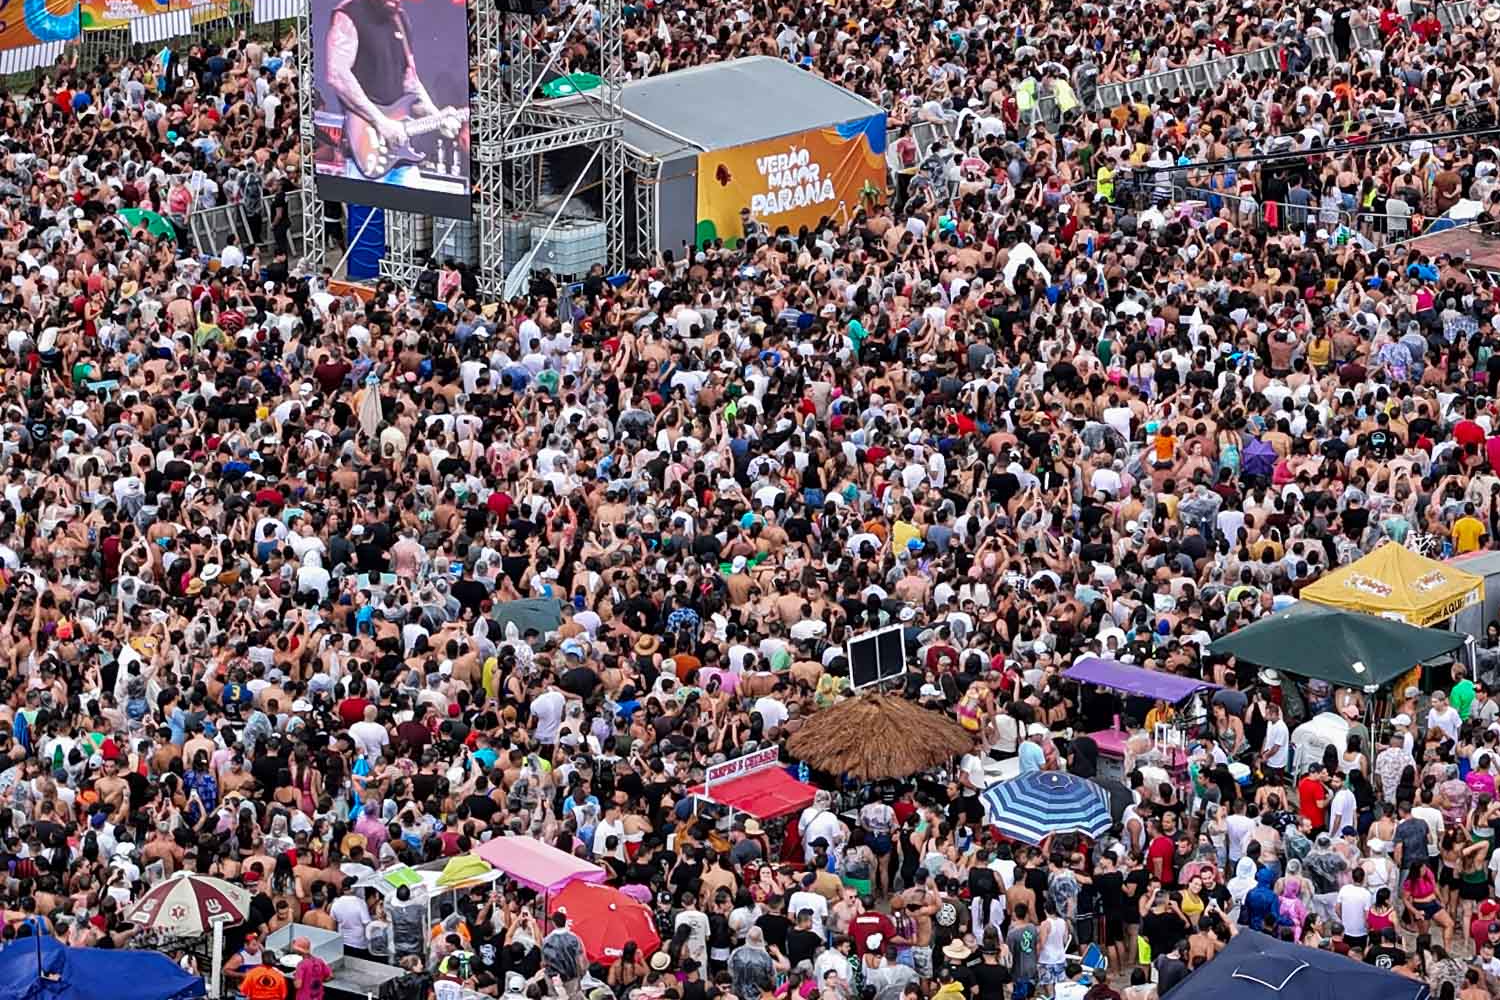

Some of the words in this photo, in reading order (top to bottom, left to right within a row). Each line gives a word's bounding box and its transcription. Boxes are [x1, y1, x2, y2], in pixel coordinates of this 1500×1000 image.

[756, 145, 810, 175] VERÃO
[768, 163, 820, 189] MAIOR
[751, 172, 836, 216] PARANÁ
[231, 684, 241, 700] 3
